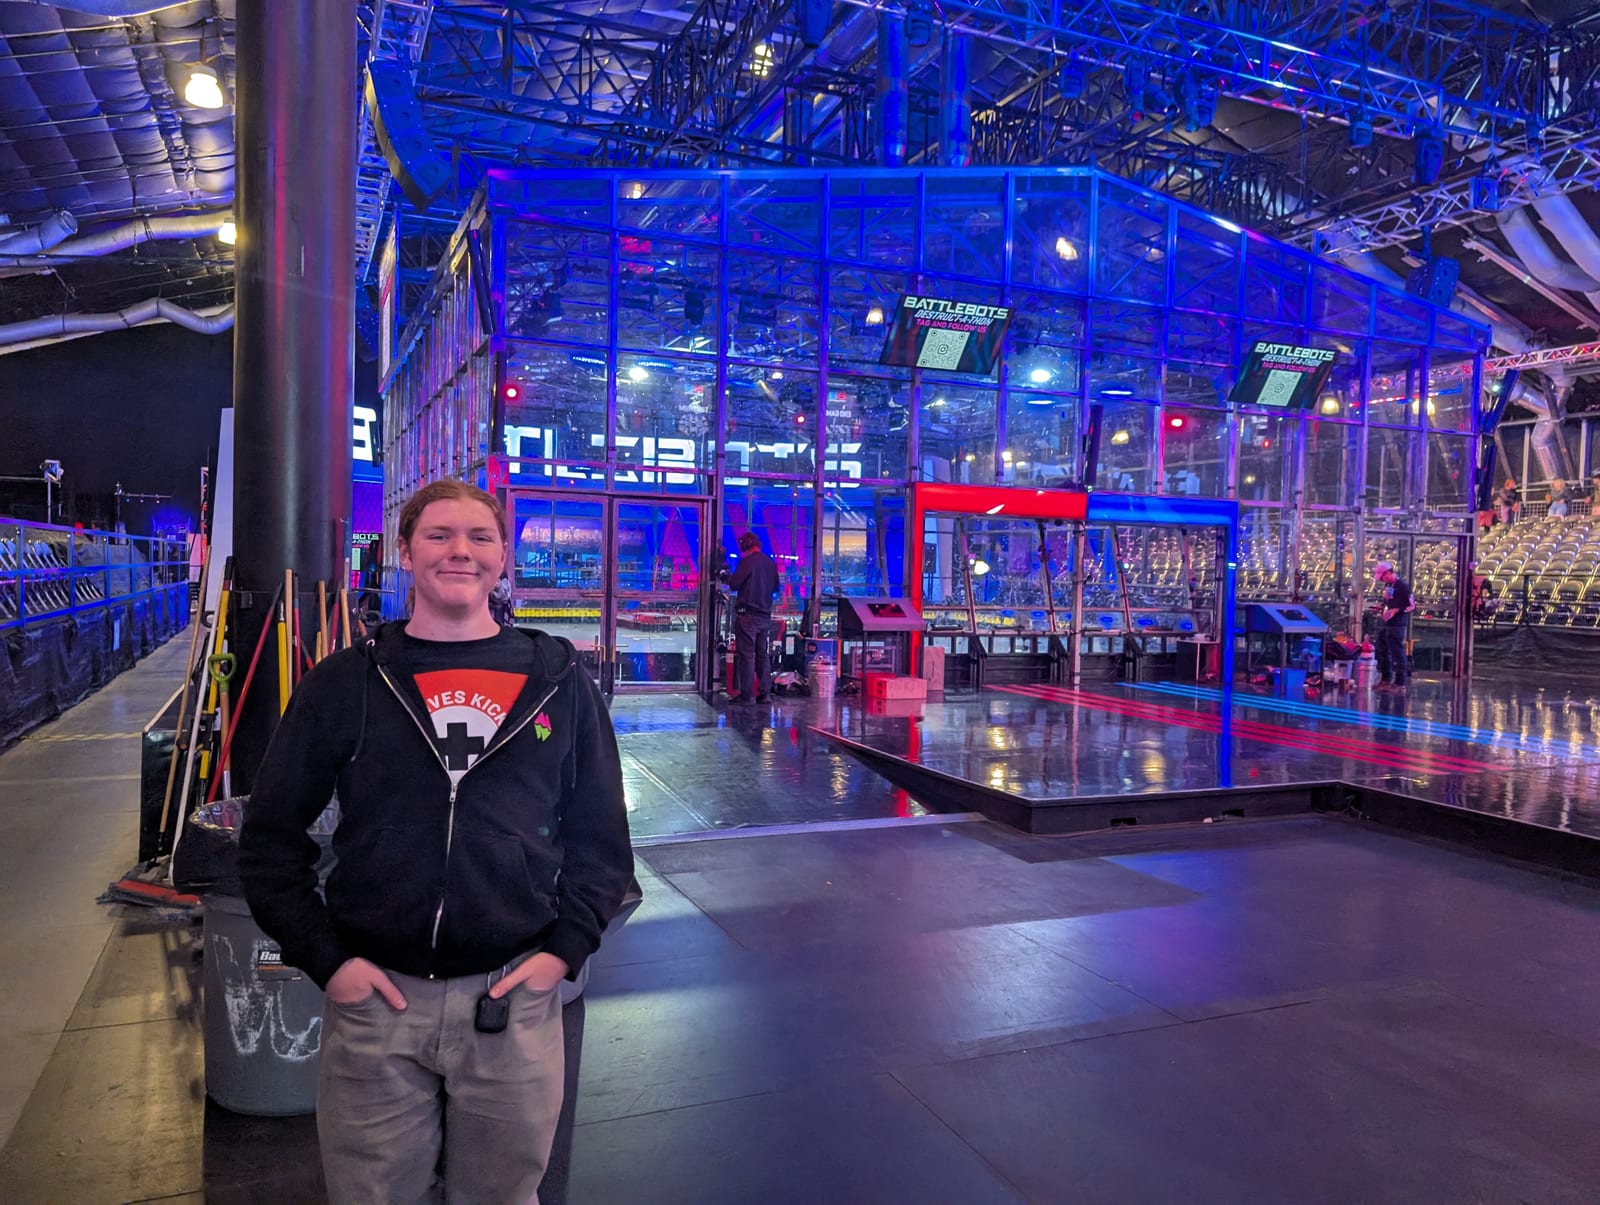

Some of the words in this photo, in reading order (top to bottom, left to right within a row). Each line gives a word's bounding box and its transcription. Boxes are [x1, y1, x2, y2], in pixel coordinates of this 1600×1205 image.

[904, 296, 1009, 319] BATTLEBOTS
[914, 309, 994, 326] DESTRUCT-A-THON
[916, 318, 930, 326] TAG
[931, 320, 947, 328] AND
[948, 322, 977, 331] FOLLOW
[977, 325, 987, 333] US
[1255, 342, 1335, 361] BATTLEBOTS
